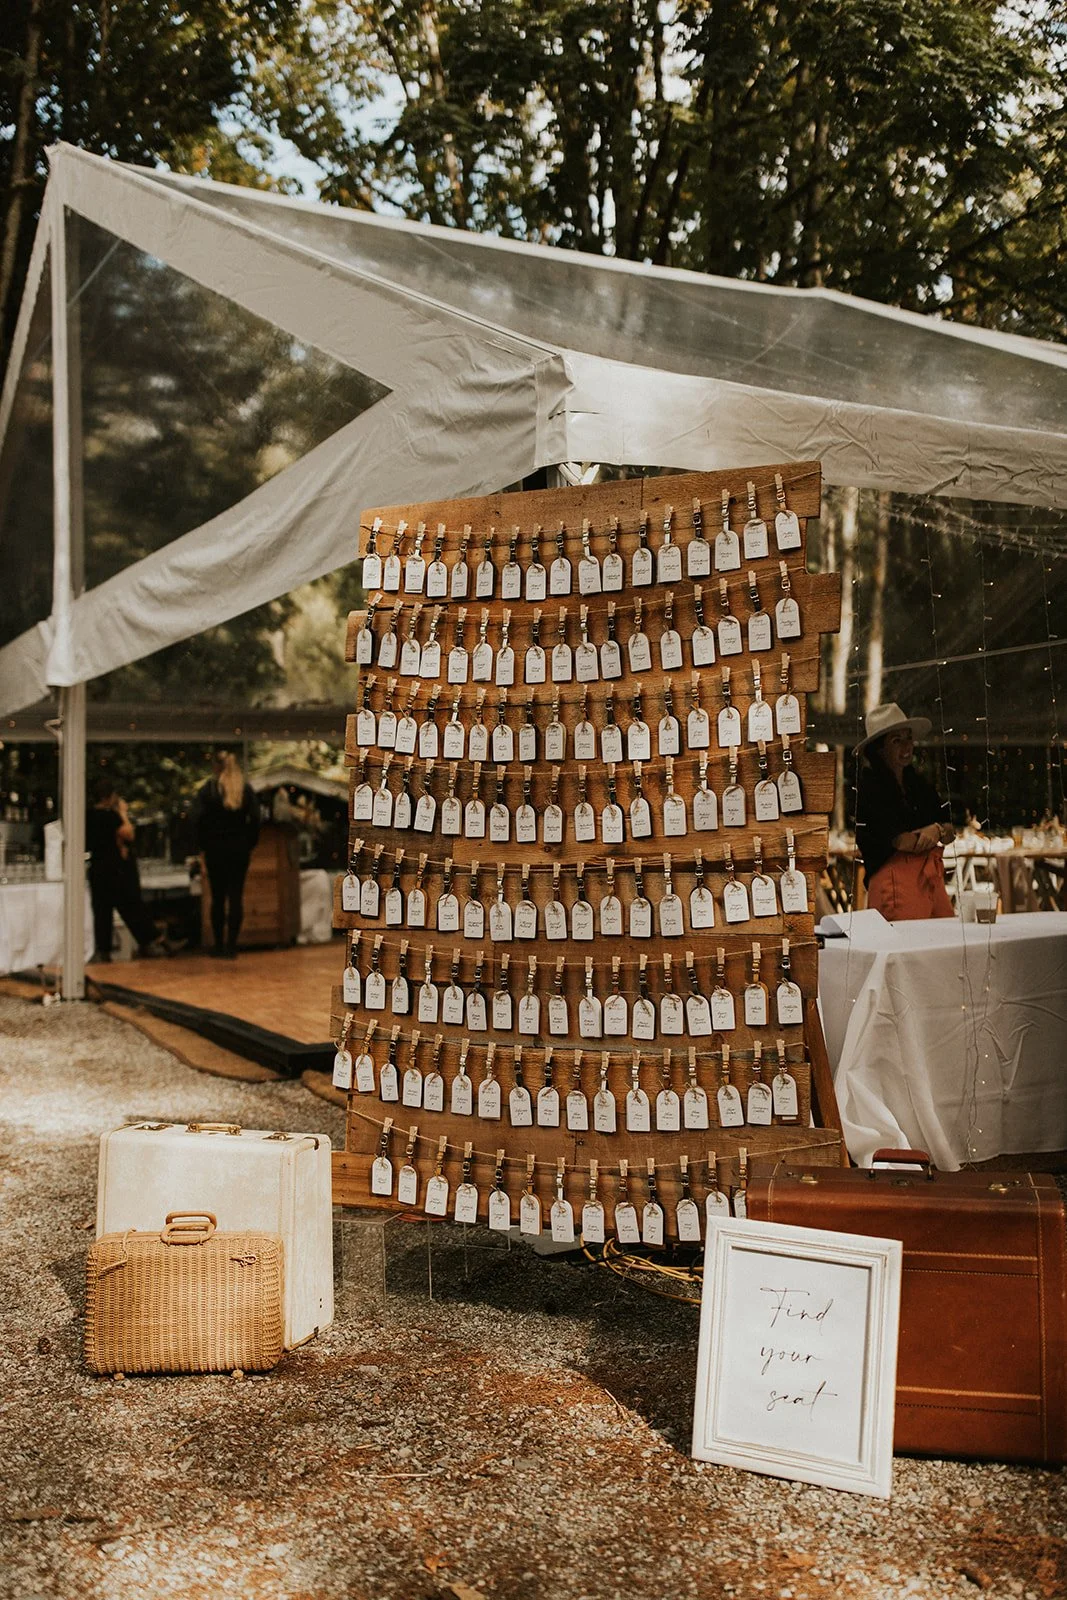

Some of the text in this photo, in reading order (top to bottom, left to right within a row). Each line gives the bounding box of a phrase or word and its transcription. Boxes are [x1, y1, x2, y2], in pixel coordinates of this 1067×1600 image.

[760, 1286, 834, 1336] Find
[760, 1346, 824, 1376] your
[767, 1381, 838, 1422] seat
